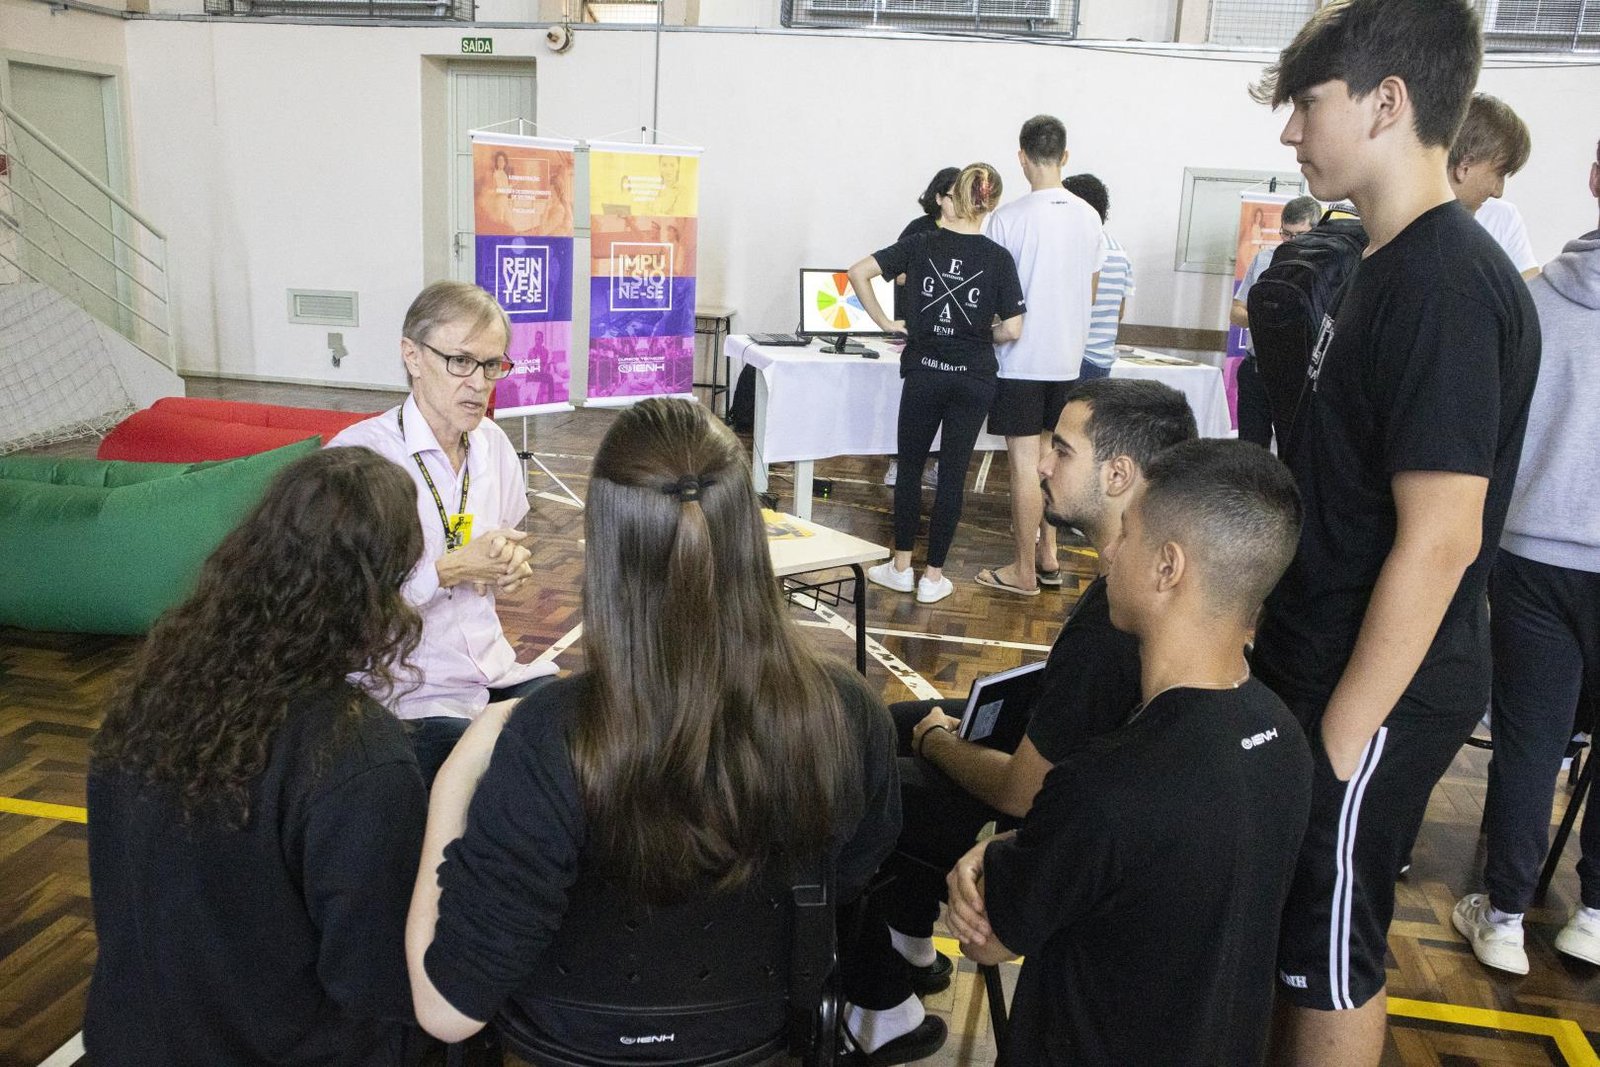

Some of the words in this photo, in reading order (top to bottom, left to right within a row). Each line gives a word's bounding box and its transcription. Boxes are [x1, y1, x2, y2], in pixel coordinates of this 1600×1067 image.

[462, 37, 492, 53] SAÍDA
[503, 257, 542, 274] REIN
[618, 254, 666, 271] IMPU
[948, 258, 963, 276] E
[503, 272, 542, 292] VEN
[922, 276, 935, 293] G
[503, 290, 542, 304] TE-SE
[618, 284, 664, 300] NE-SE
[967, 287, 980, 304] C
[939, 302, 952, 319] A
[933, 325, 954, 336] IENH
[515, 365, 541, 375] IENH
[633, 363, 665, 373] IENH
[1251, 727, 1279, 747] IENH
[636, 1033, 675, 1044] IENH
